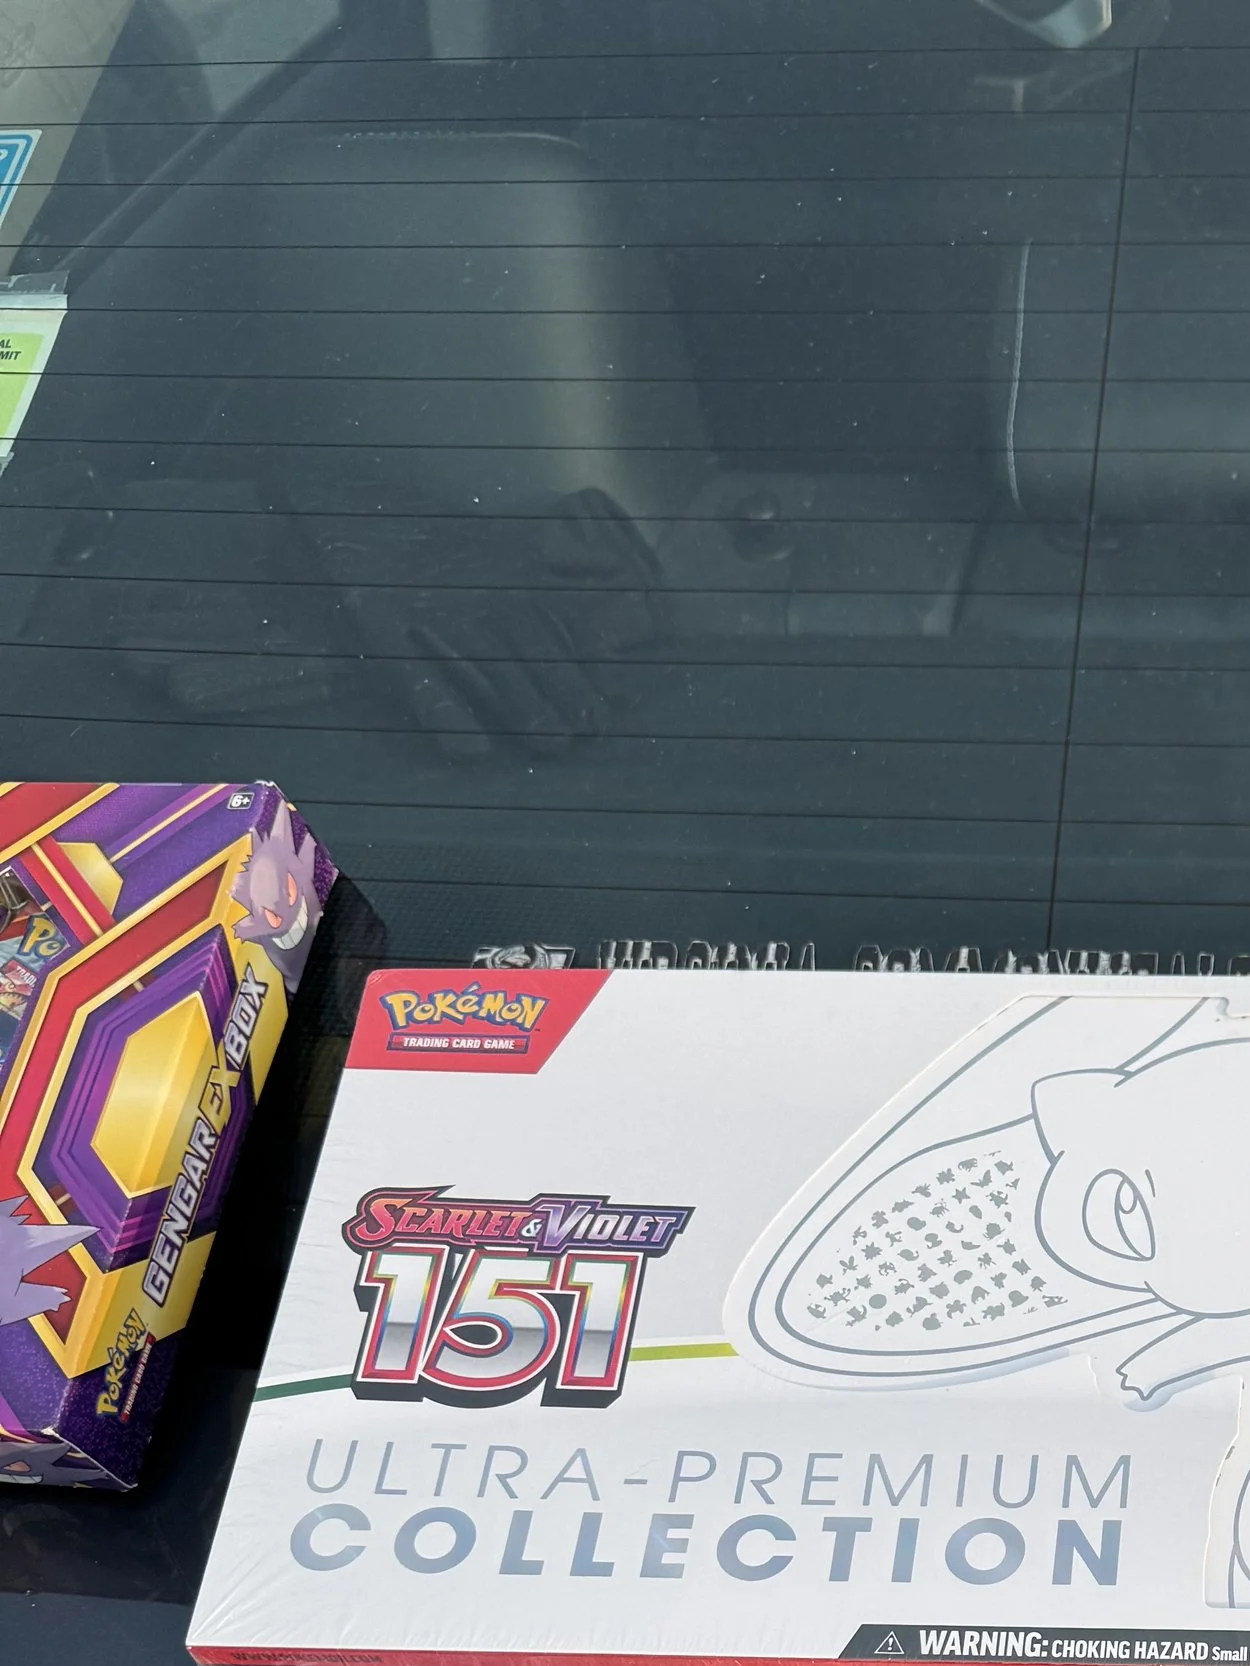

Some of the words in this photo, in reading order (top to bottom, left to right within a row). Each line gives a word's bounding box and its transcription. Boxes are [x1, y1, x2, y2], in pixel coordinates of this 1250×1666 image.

[231, 794, 251, 808] 6+
[380, 982, 550, 1032] Pokémon
[402, 1036, 449, 1049] TRADING
[452, 1037, 481, 1049] CARD
[484, 1038, 515, 1050] GAME
[142, 1116, 219, 1308] GENGAR
[224, 962, 268, 1069] BOX
[521, 1217, 542, 1239] &
[356, 1243, 648, 1396] 151
[97, 1308, 149, 1418] Pokémon
[305, 1437, 1133, 1509] ULTRA-PREMIUM
[289, 1502, 1123, 1586] COLLECTION
[919, 1629, 1049, 1658] WARNING:
[1051, 1639, 1131, 1660] CHOKING
[1134, 1641, 1209, 1660] HAZARD
[1212, 1646, 1248, 1662] Small
